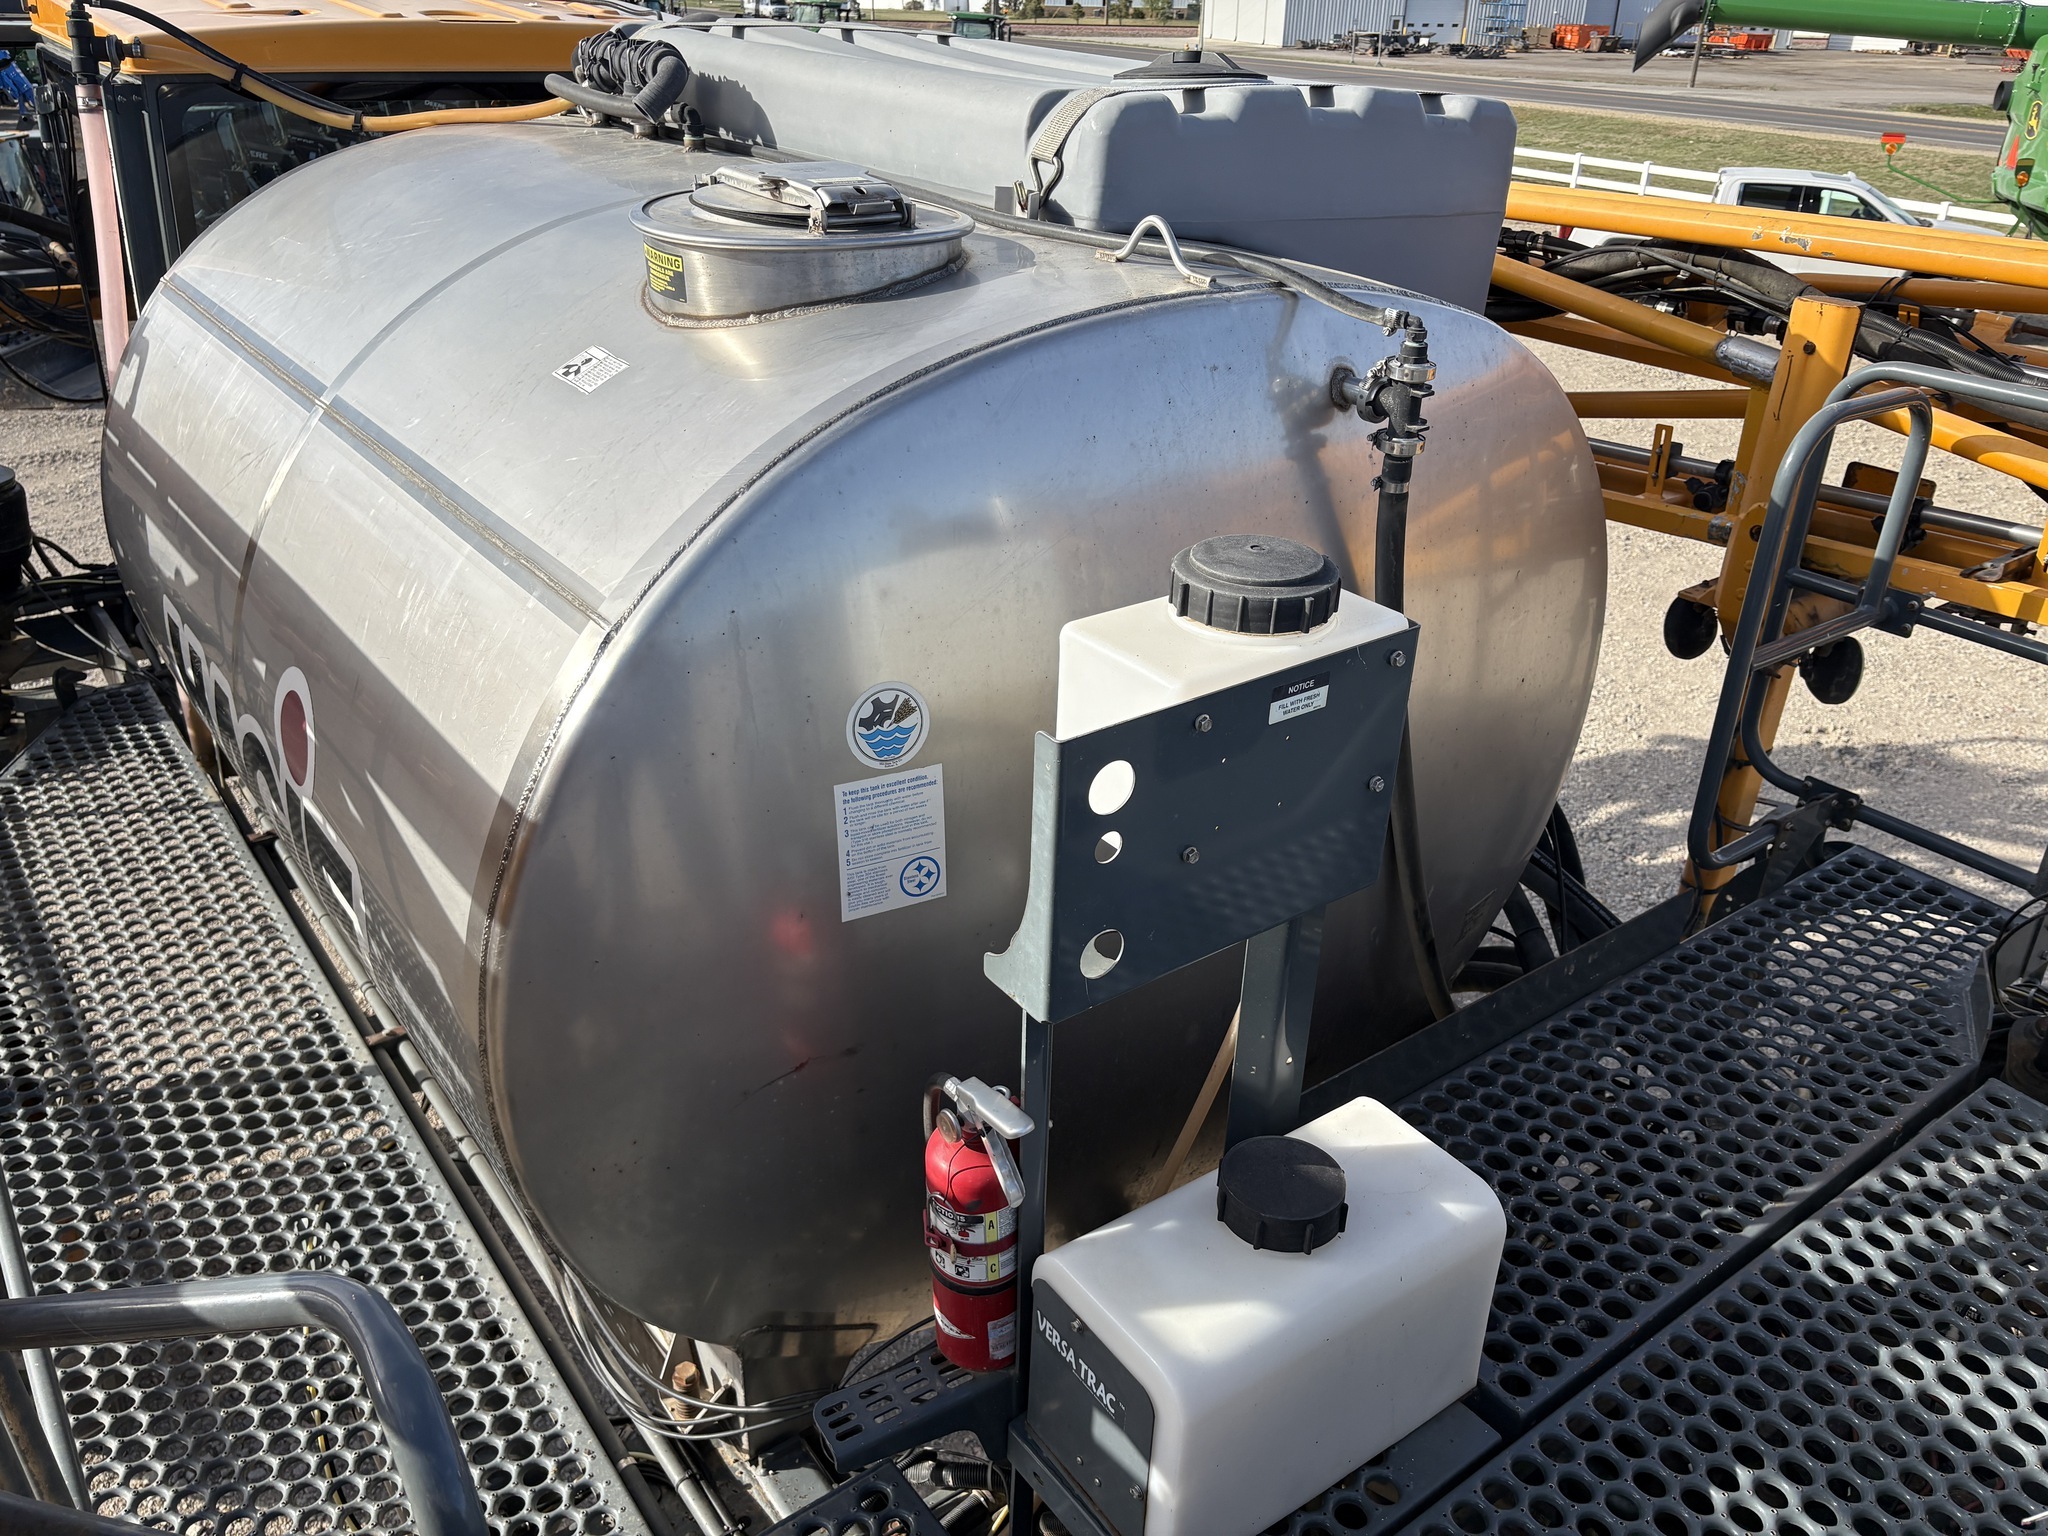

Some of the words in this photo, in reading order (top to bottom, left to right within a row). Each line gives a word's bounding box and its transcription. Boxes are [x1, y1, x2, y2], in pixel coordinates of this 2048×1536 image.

[646, 246, 680, 269] WARNING
[1287, 679, 1315, 695] NOTICE
[1278, 702, 1289, 710] FILL
[1289, 698, 1303, 707] WITH
[1303, 692, 1321, 702] FRESH
[1282, 705, 1300, 716] WATER
[1300, 701, 1315, 710] ONLY
[849, 789, 859, 797] keep
[886, 779, 906, 788] excellent
[851, 794, 871, 804] following
[872, 789, 897, 799] procedures
[988, 1220, 995, 1230] A
[990, 1263, 997, 1273] C
[1037, 1310, 1076, 1370] VERSA
[1079, 1358, 1116, 1413] TRAC
